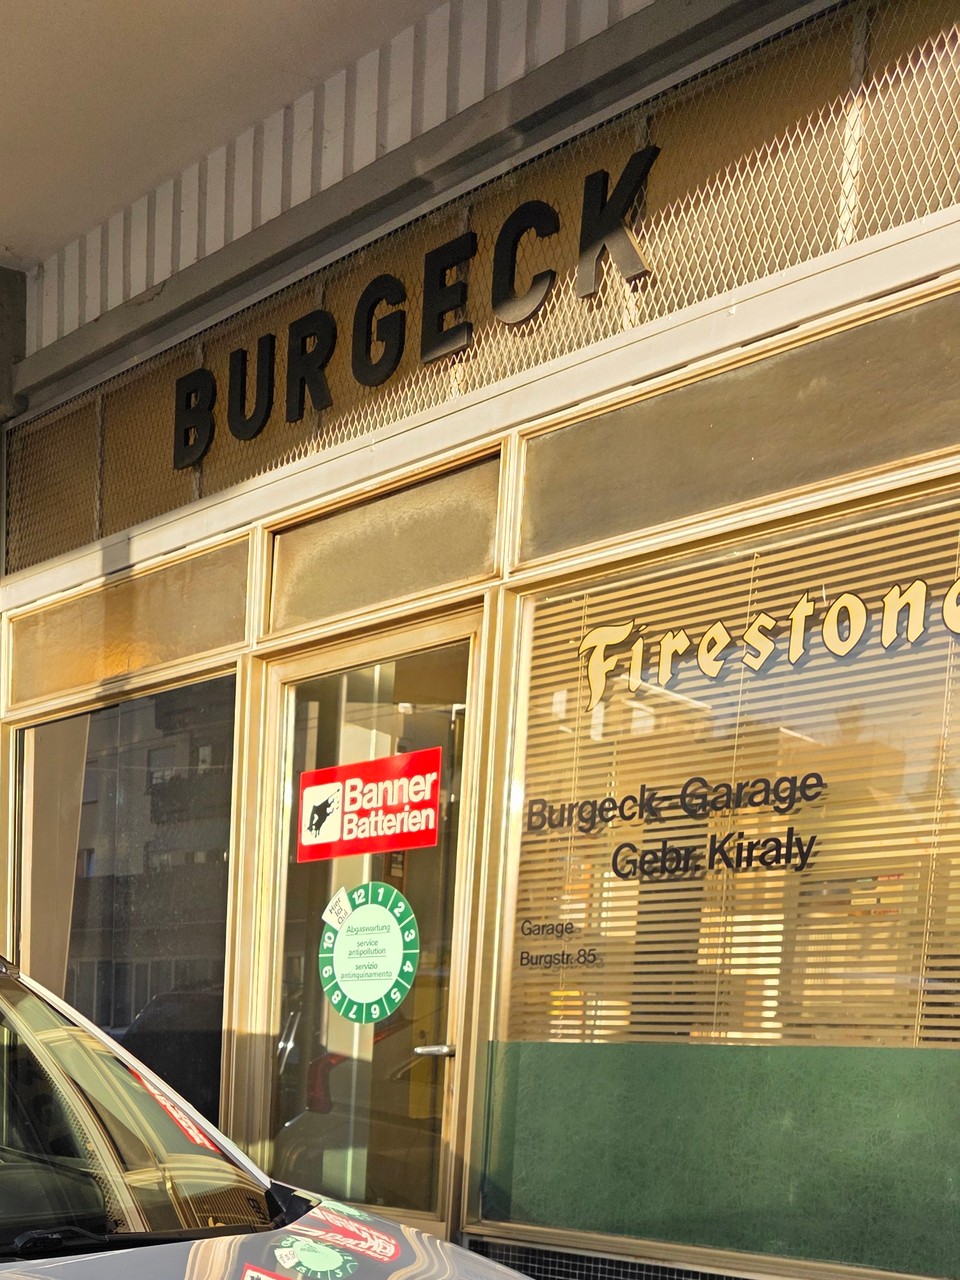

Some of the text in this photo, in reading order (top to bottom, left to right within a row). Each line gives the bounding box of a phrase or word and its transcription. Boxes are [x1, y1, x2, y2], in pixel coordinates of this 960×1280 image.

[172, 143, 661, 470] BURGECK
[343, 771, 438, 812] Banner
[342, 807, 435, 841] Batterien
[611, 827, 817, 880] Gebr. Kiraly
[352, 888, 366, 905] 12
[377, 887, 385, 902] 1
[393, 901, 406, 917] 2
[346, 924, 391, 935] Abgaswartung
[404, 929, 416, 942] 3
[521, 920, 574, 938] Garage
[323, 932, 335, 949] 10
[356, 939, 379, 947] service
[348, 947, 386, 957] antipollution
[520, 948, 597, 969] Burgstr. 85
[355, 962, 378, 970] servizio
